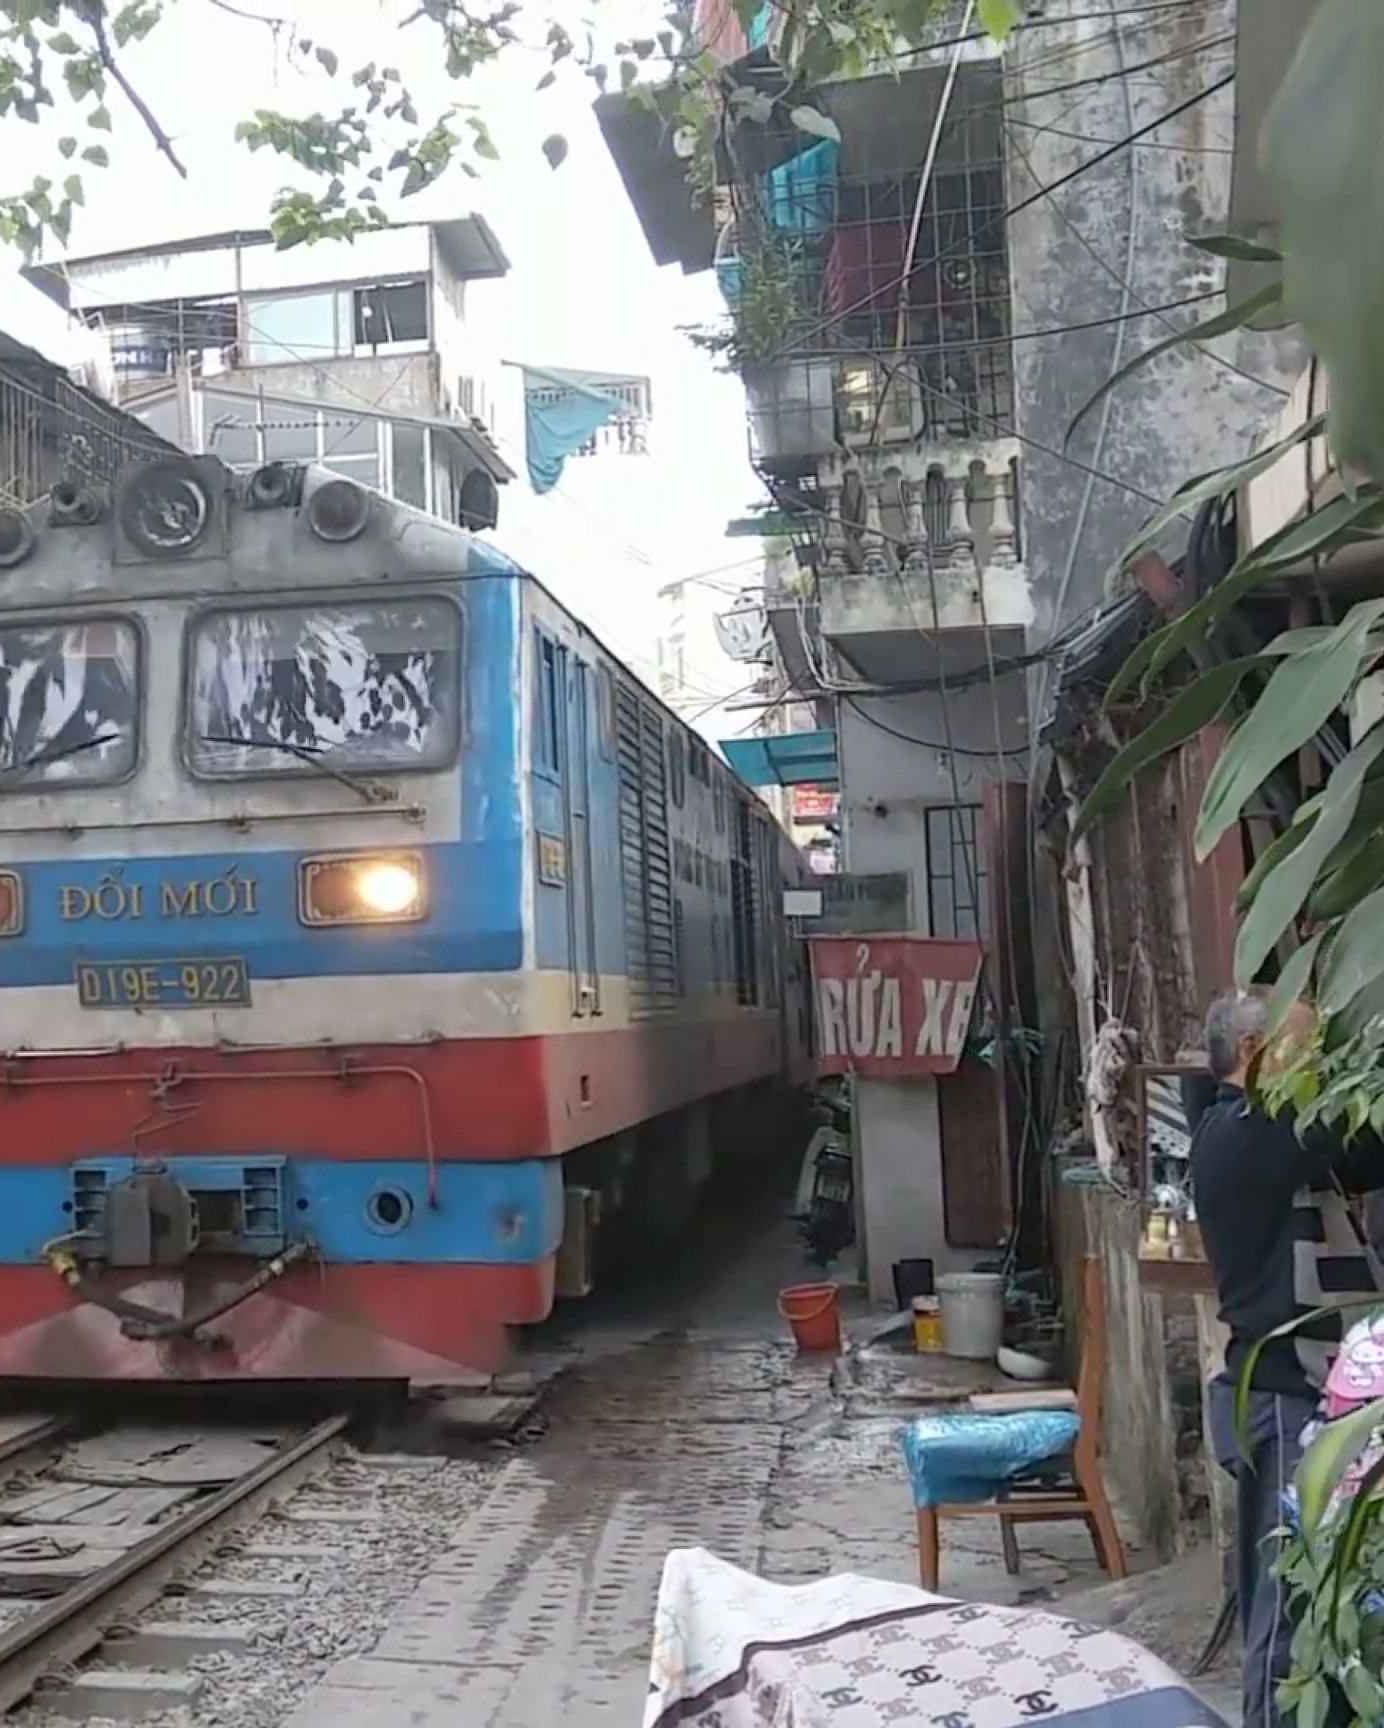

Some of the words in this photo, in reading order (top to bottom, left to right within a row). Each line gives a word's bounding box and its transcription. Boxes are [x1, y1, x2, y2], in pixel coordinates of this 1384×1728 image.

[58, 862, 142, 920] ĐỔI
[161, 863, 257, 916] MỚI
[81, 965, 241, 1002] D19E-922
[818, 943, 902, 1057] RỬA
